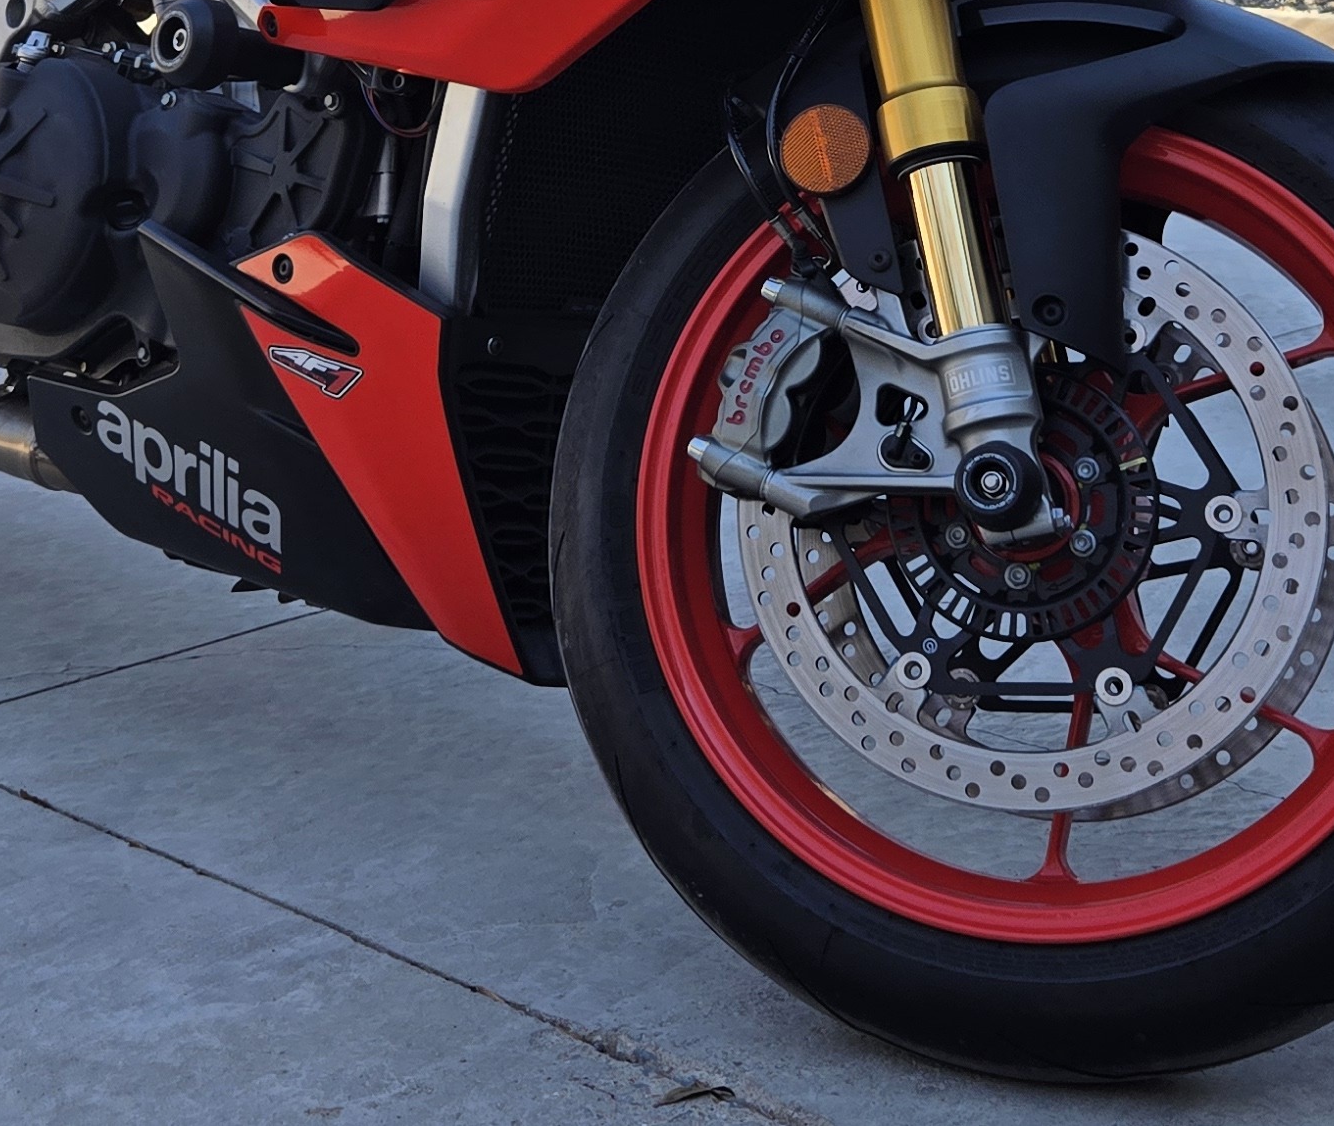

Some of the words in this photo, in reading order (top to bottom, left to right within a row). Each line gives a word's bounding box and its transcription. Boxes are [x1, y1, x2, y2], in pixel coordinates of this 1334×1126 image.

[631, 191, 761, 396] SUPERCORS
[273, 350, 357, 394] AF1
[725, 327, 786, 425] brembo
[949, 364, 1010, 393] ÖHLINS
[96, 399, 283, 555] aprilia
[151, 484, 283, 575] RACING
